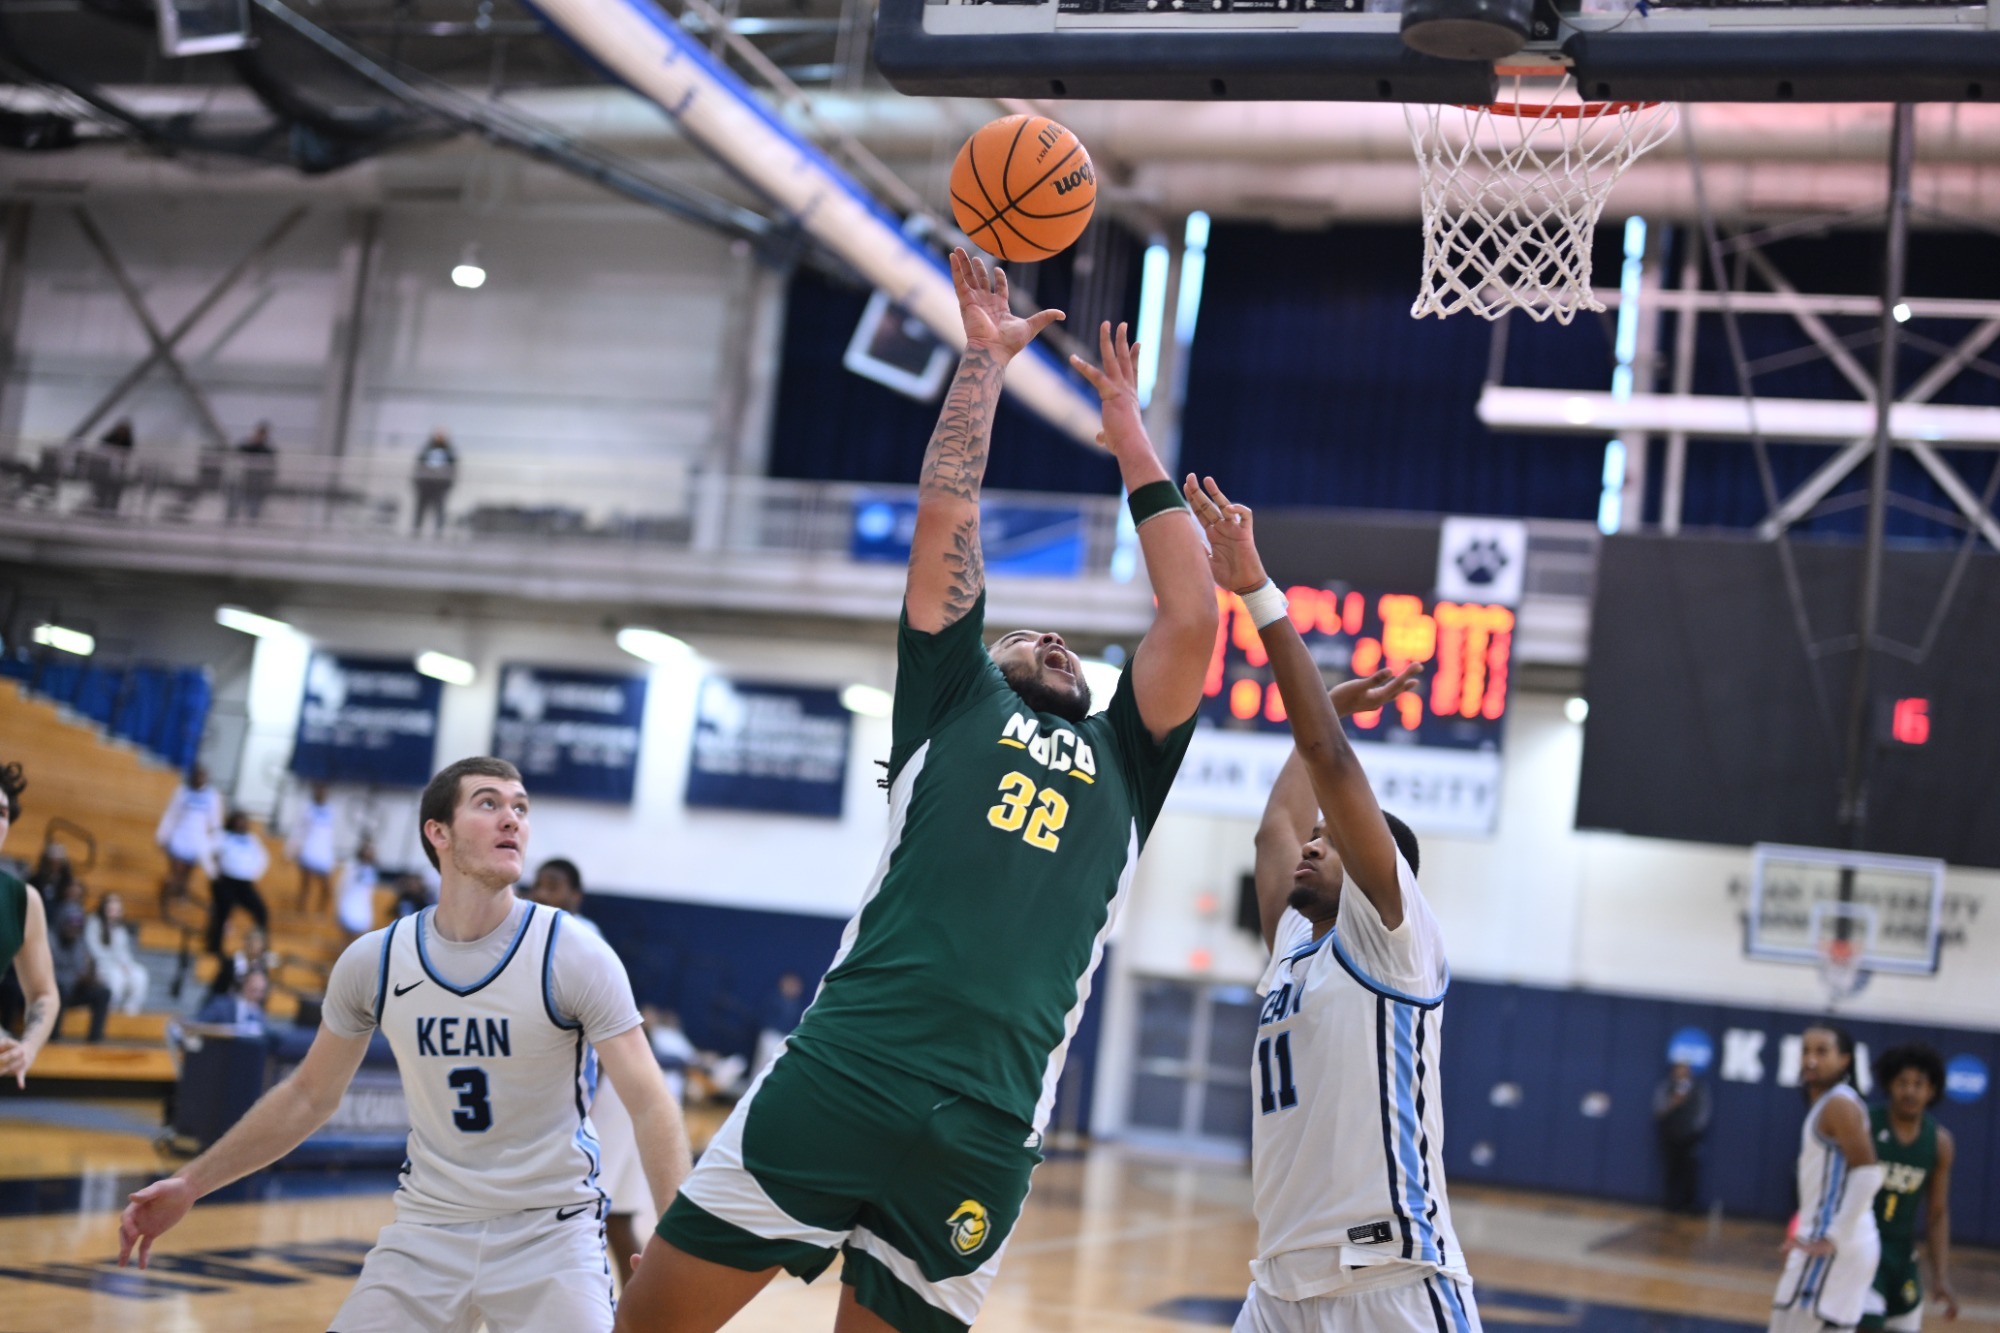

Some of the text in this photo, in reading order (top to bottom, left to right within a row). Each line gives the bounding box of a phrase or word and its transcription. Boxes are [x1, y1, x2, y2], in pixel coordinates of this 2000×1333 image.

[1036, 147, 1048, 164] NXT
[986, 770, 1070, 854] 32
[416, 1016, 511, 1057] KEAN
[447, 1066, 494, 1133] 3
[1258, 1030, 1298, 1116] 11
